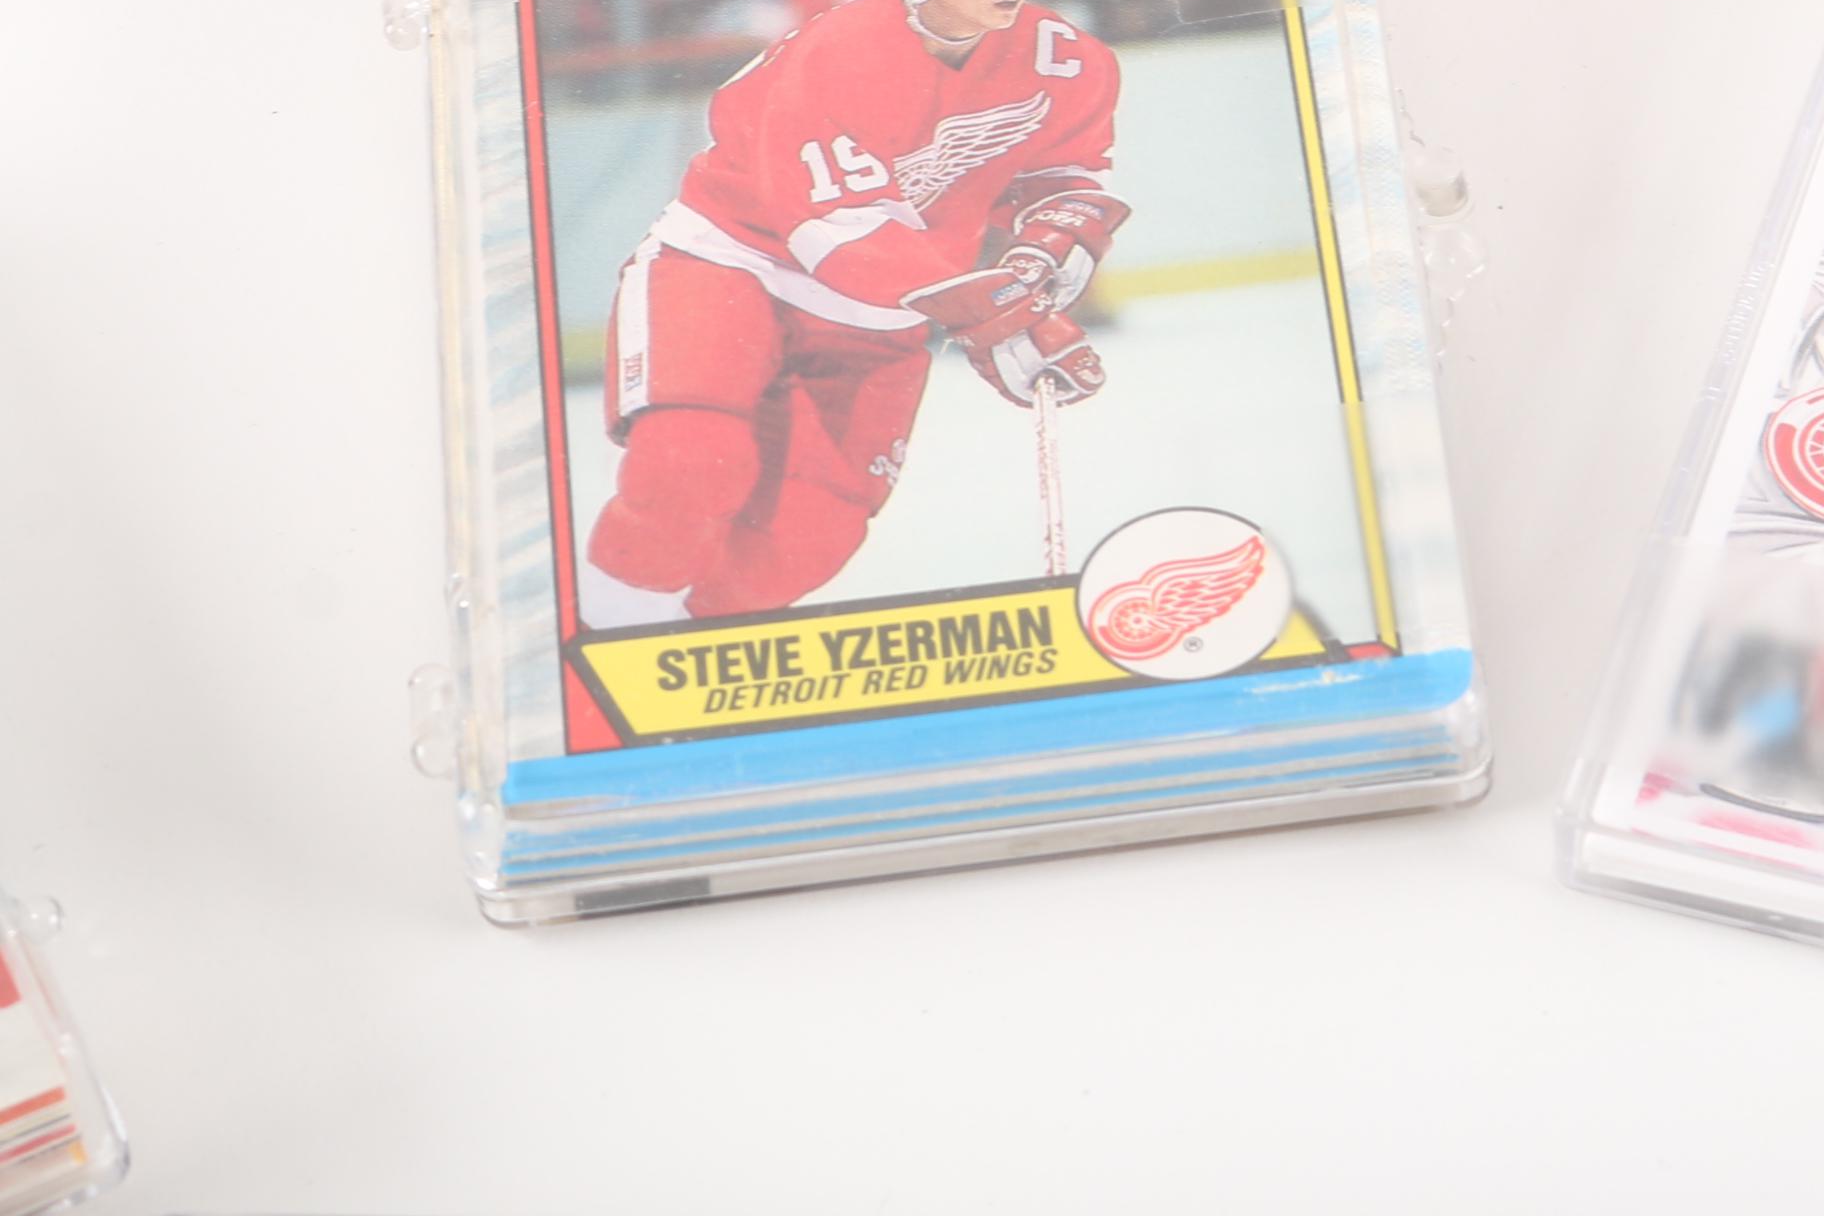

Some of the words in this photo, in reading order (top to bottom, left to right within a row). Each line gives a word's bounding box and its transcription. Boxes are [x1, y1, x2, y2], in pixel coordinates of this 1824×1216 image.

[1036, 18, 1082, 78] C
[655, 637, 803, 695] STEVE
[818, 605, 1054, 672] YZERMAN
[702, 673, 854, 715] DETROIT
[862, 661, 926, 701] RED
[944, 649, 1059, 690] WINGS
